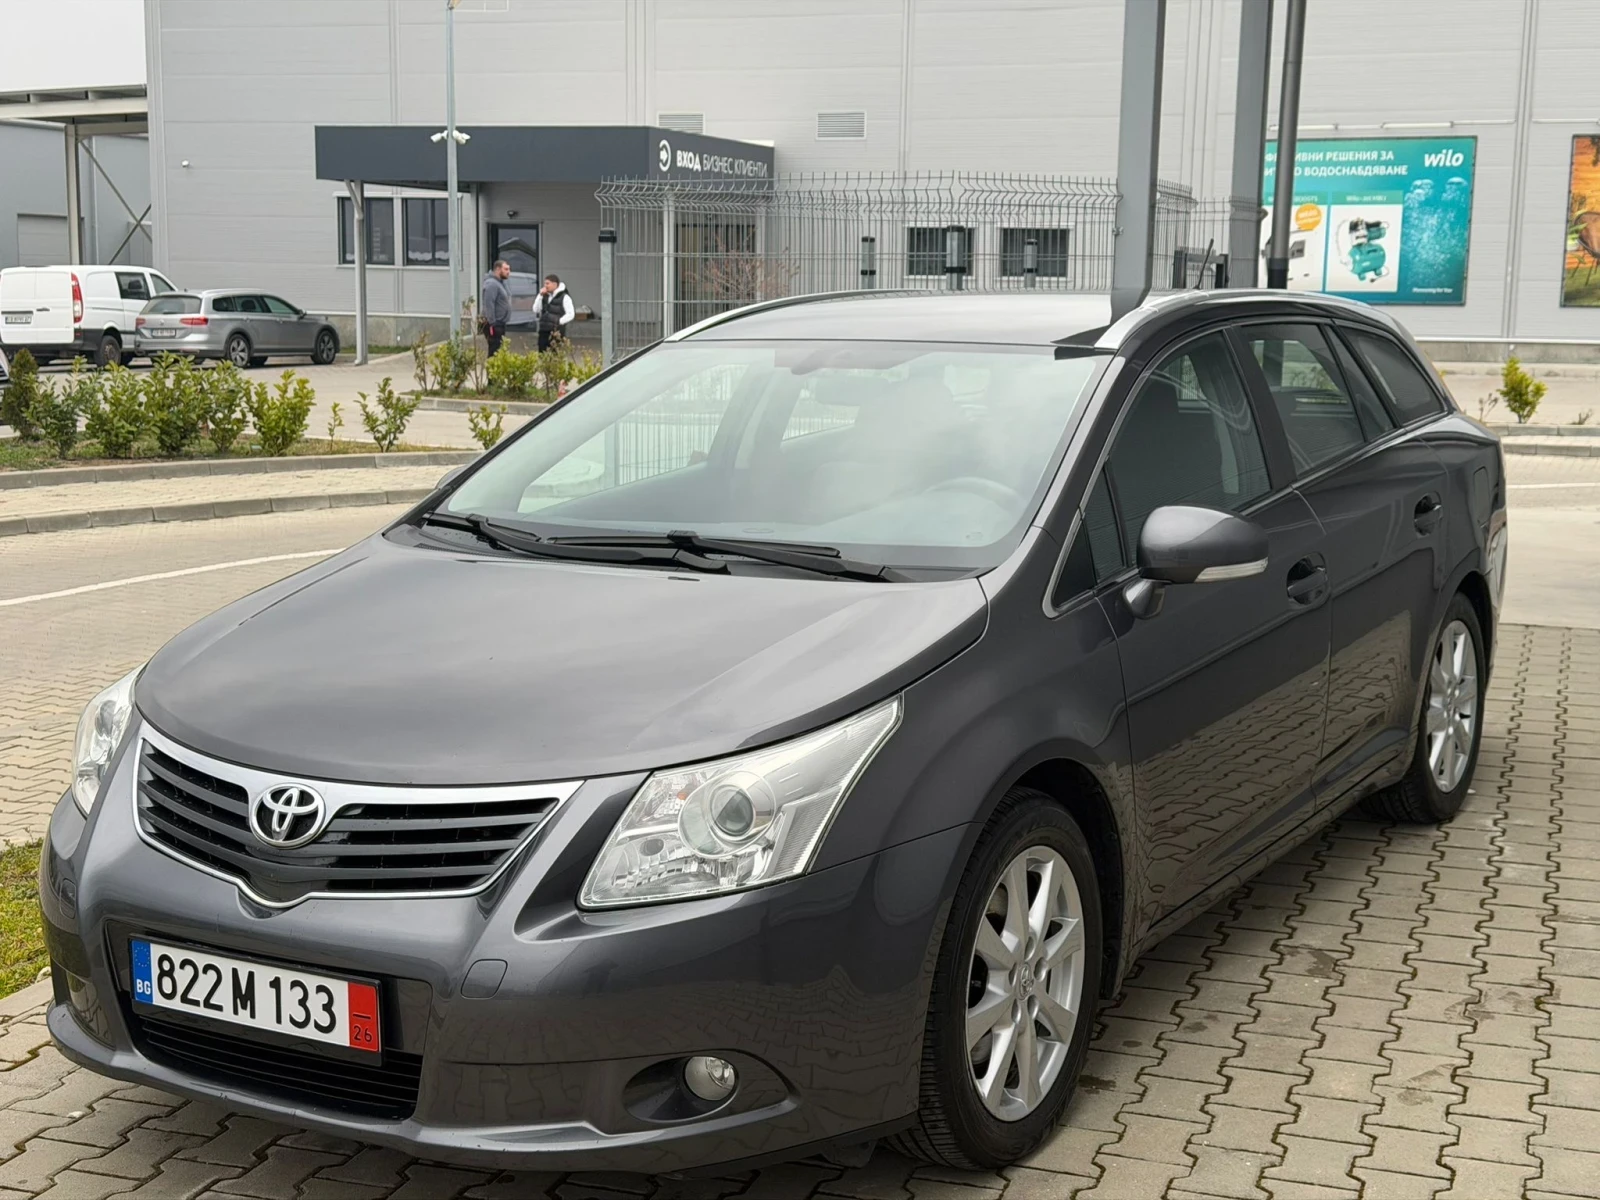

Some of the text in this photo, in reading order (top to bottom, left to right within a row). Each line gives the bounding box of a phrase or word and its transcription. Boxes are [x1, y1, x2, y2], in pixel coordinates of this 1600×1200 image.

[676, 150, 768, 178] ВХОД БИЗНЕС КЛИЕНТИ
[1326, 151, 1378, 161] РЕШЕНИЯ
[1380, 150, 1394, 160] ЗА
[1424, 149, 1464, 167] wilo
[1304, 165, 1408, 177] ВОДОСНАБДЯВАНЕ
[136, 979, 151, 995] BG
[157, 953, 337, 1034] 822 M 133
[353, 1025, 373, 1043] 26
